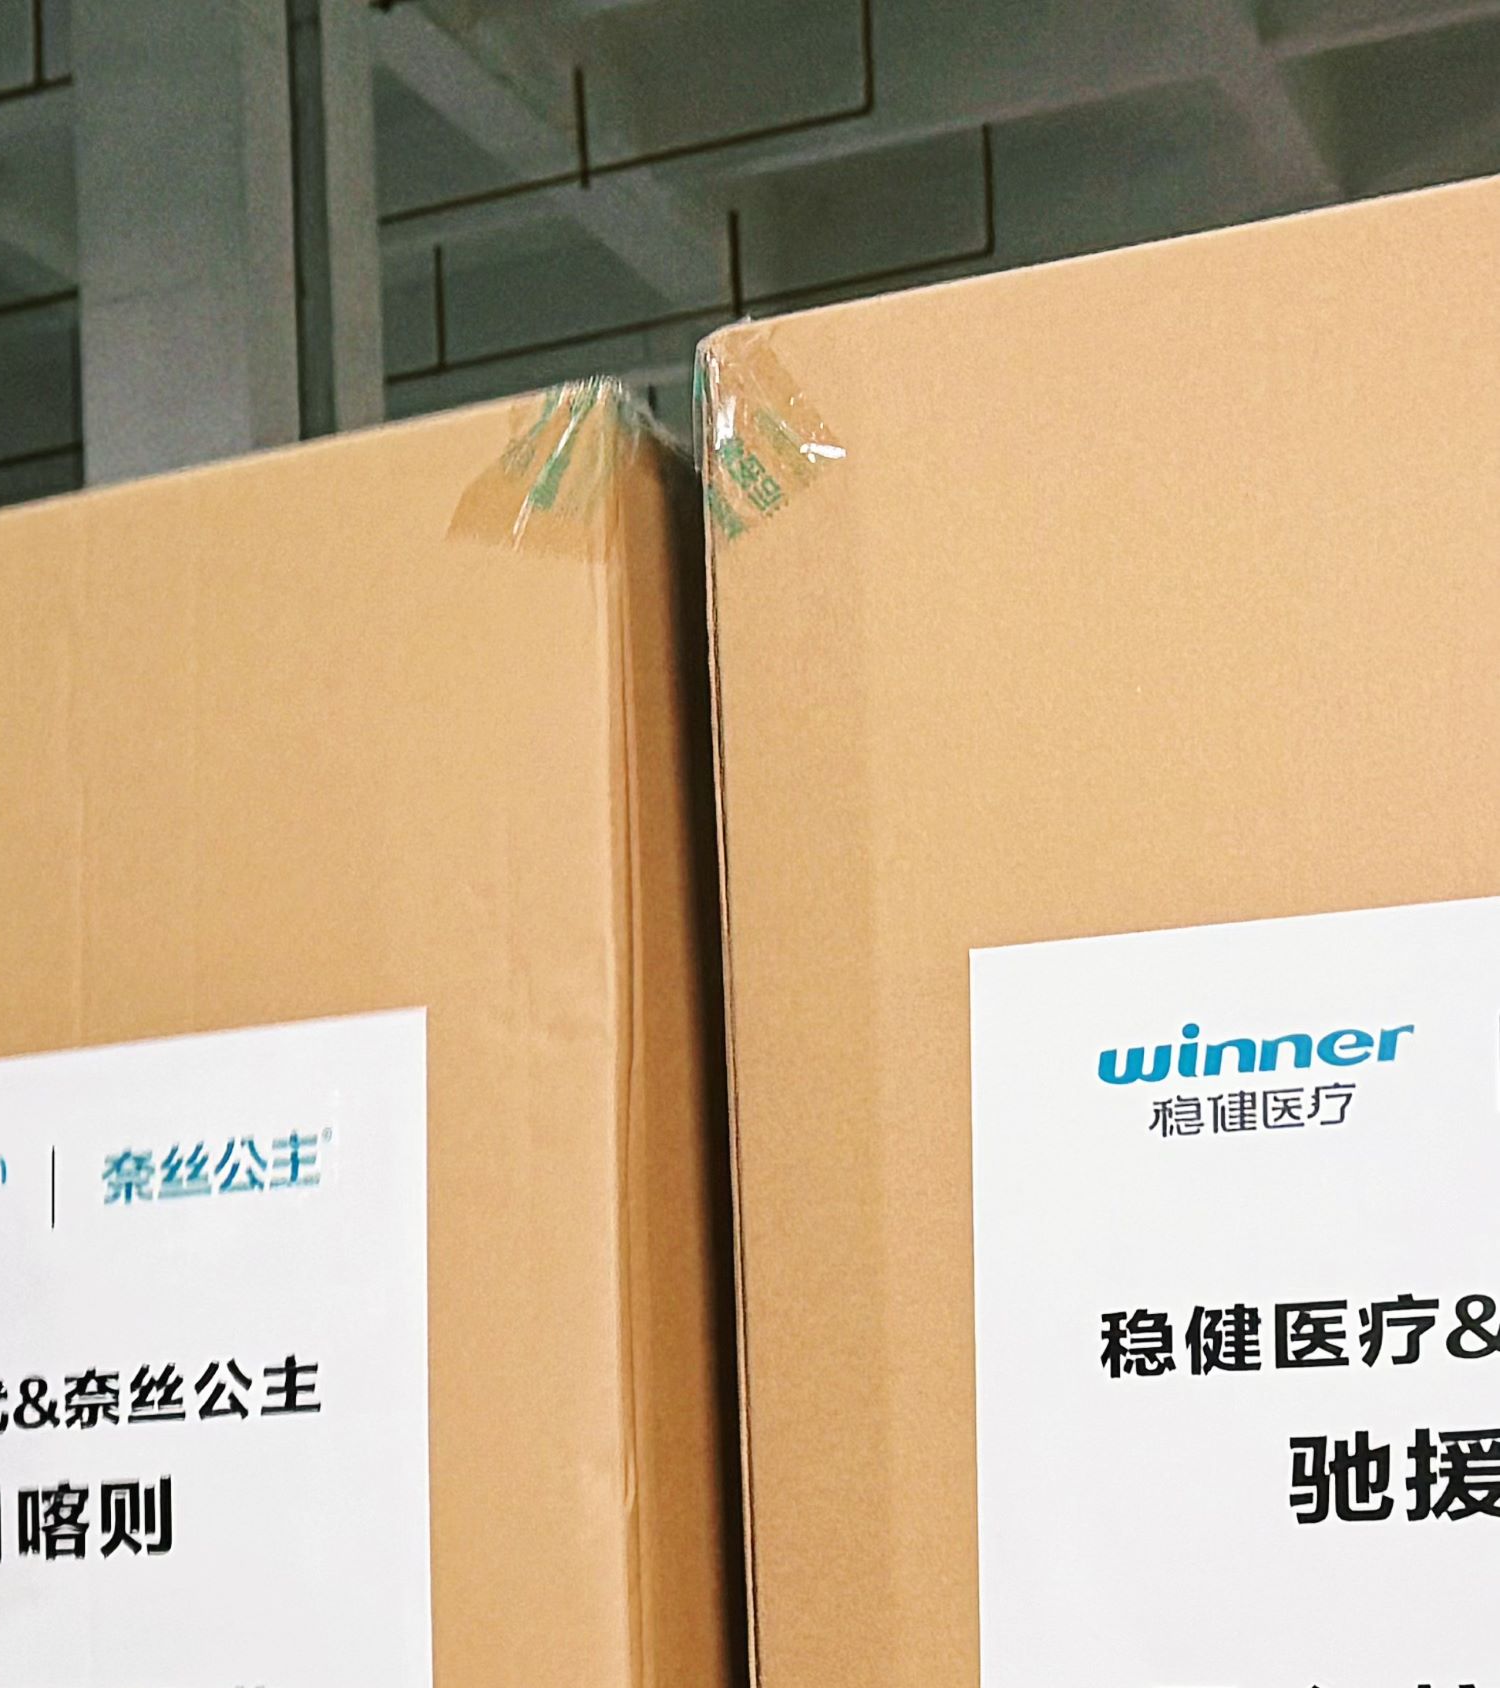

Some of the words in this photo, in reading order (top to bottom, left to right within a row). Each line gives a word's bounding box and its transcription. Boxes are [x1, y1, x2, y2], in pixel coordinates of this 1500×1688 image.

[1097, 1022, 1415, 1086] winner
[1148, 1082, 1357, 1138] 稳健医疗
[102, 1133, 317, 1204] 奈丝公主
